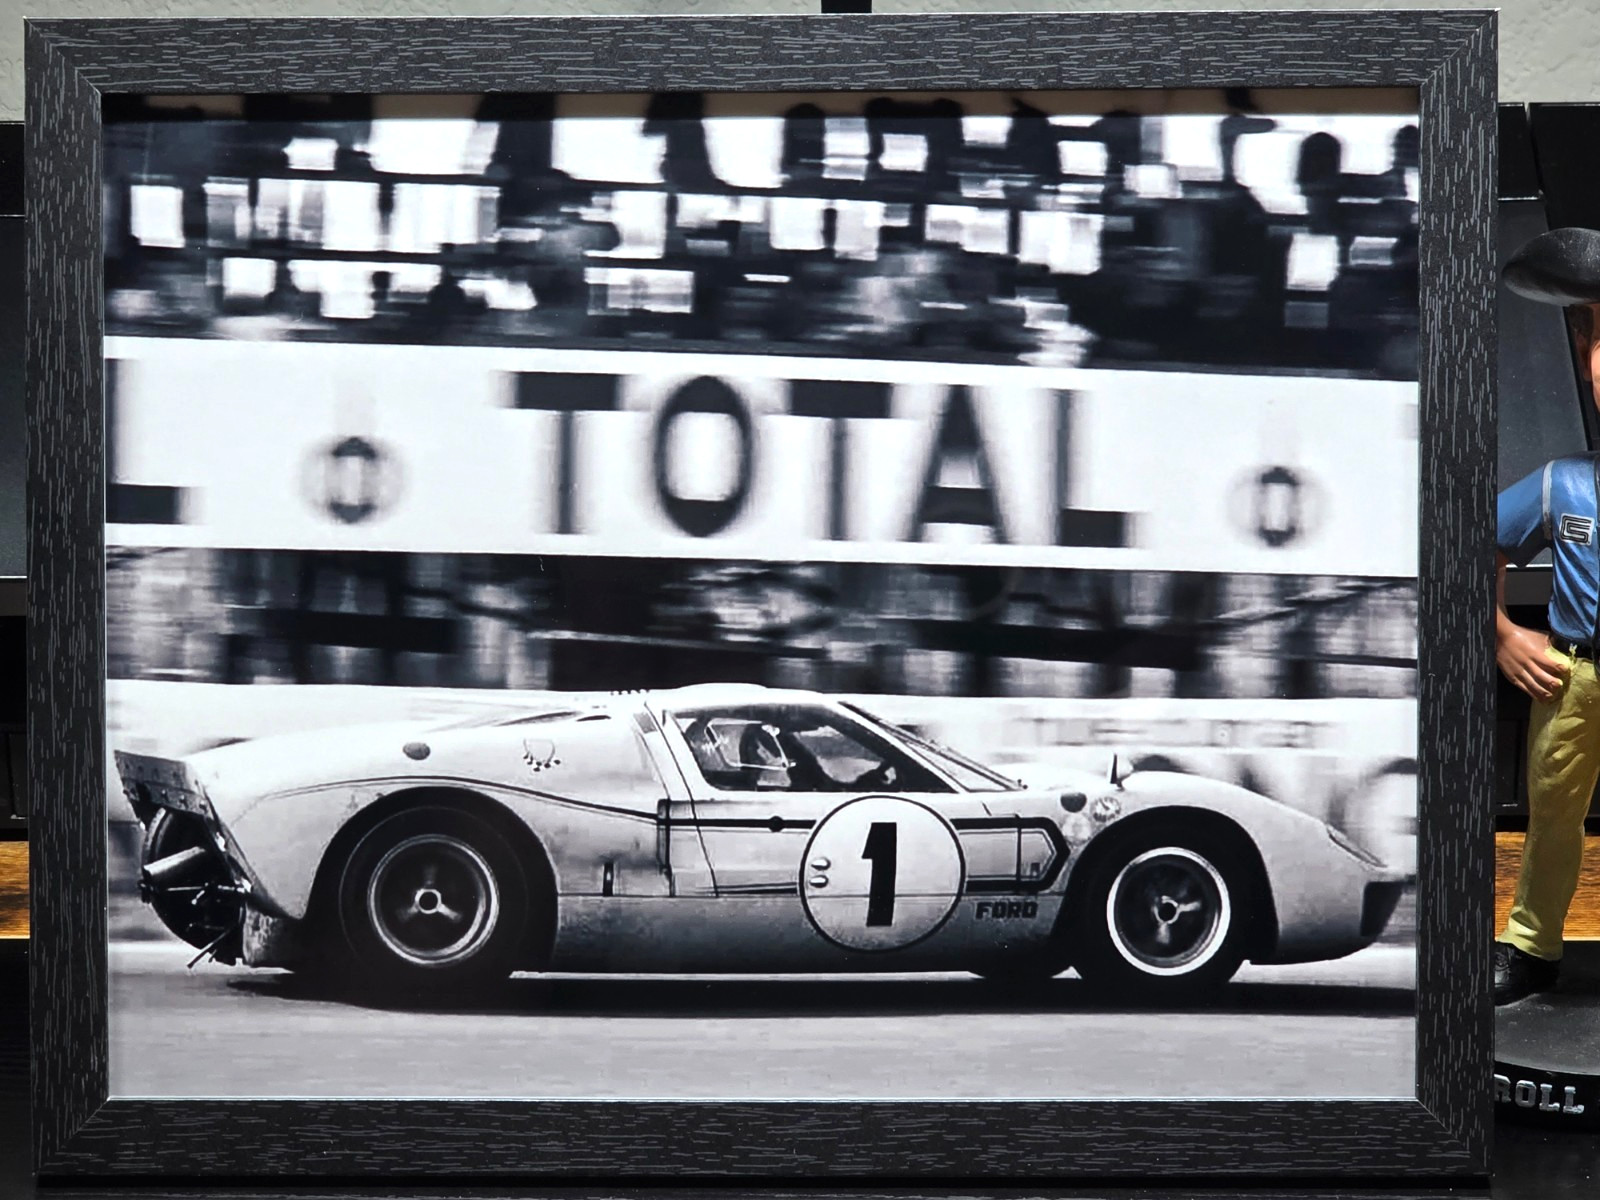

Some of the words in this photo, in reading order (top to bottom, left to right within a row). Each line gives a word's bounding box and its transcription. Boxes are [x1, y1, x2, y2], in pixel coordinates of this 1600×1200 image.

[500, 370, 1140, 548] TOTAL
[861, 822, 898, 927] 1
[975, 902, 1038, 919] FORD
